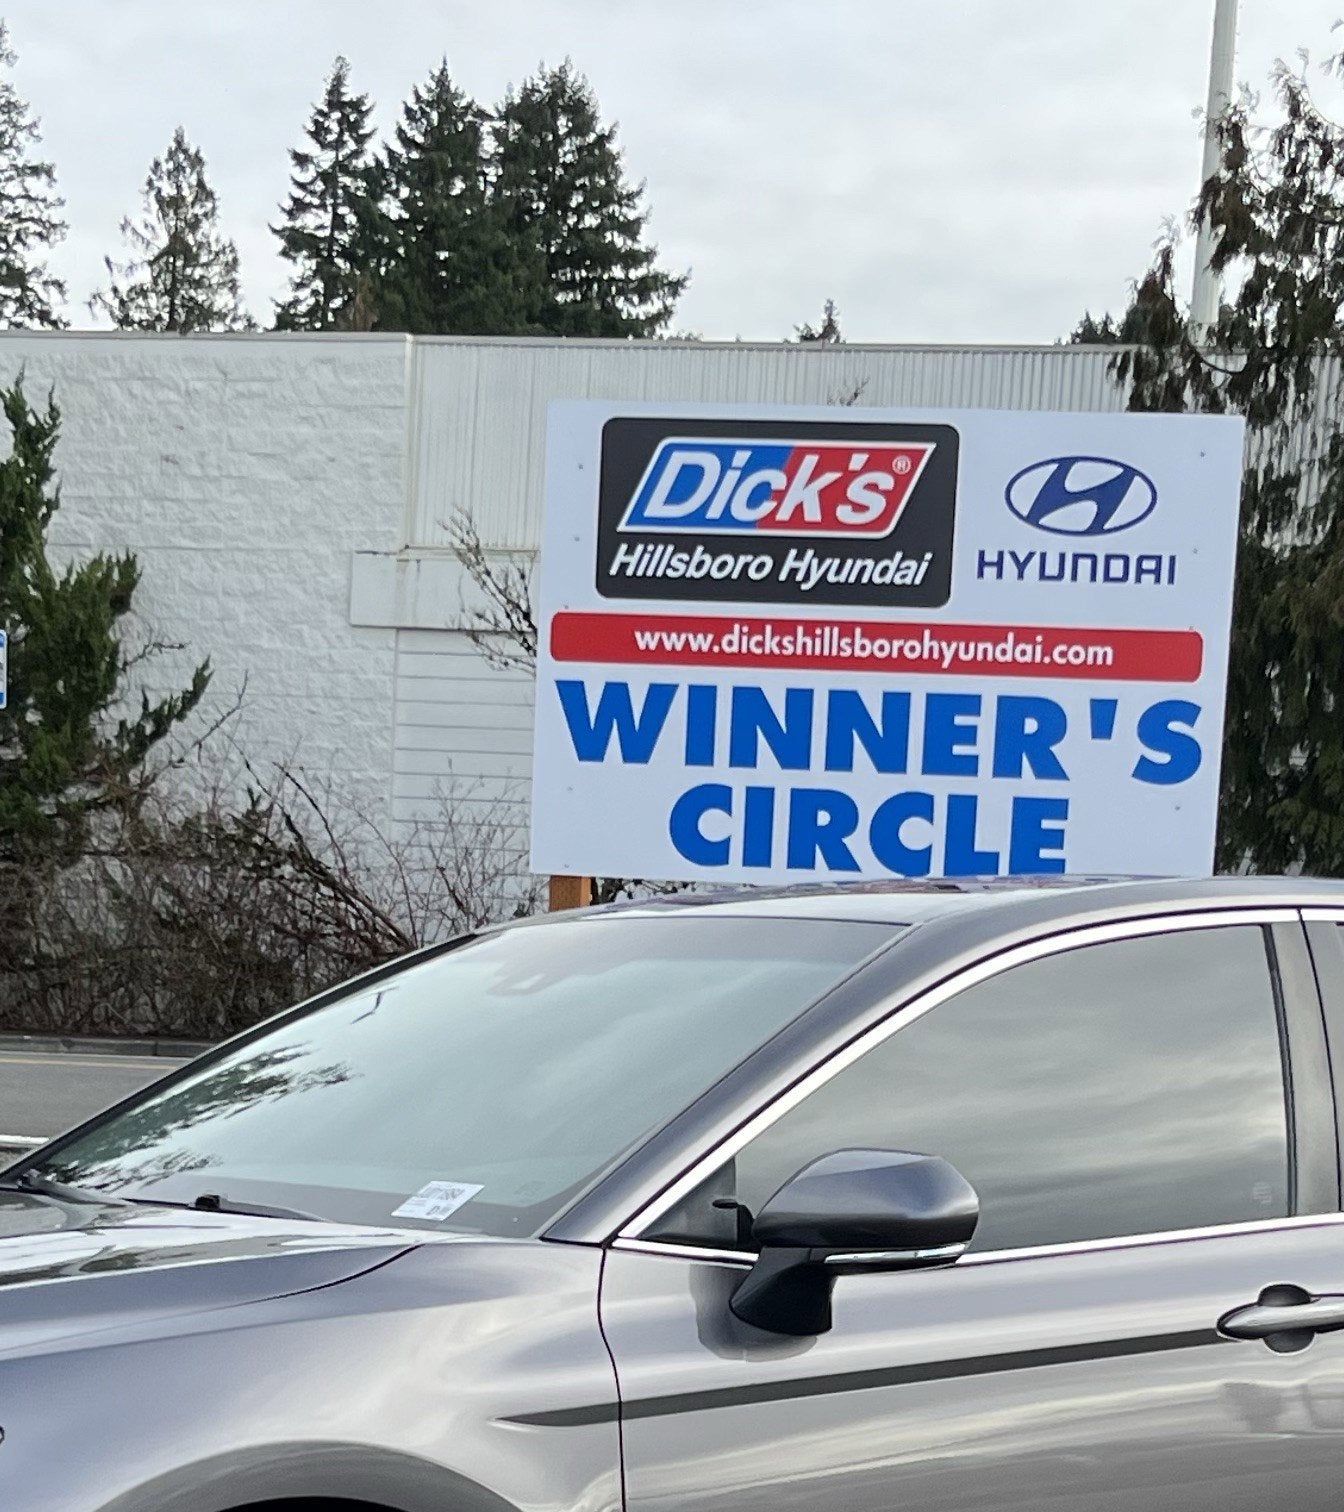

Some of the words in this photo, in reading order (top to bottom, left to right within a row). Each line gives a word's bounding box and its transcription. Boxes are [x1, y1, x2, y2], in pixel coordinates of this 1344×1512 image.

[643, 450, 896, 525] Dick's
[608, 542, 774, 582] Hillsboro
[778, 547, 934, 591] Hyundai
[976, 549, 1177, 585] HYUNDAI
[634, 623, 1115, 670] www.dickshillsborohyundai.com
[555, 679, 1203, 785] WINNER'S
[669, 783, 1070, 877] CIRCLE
